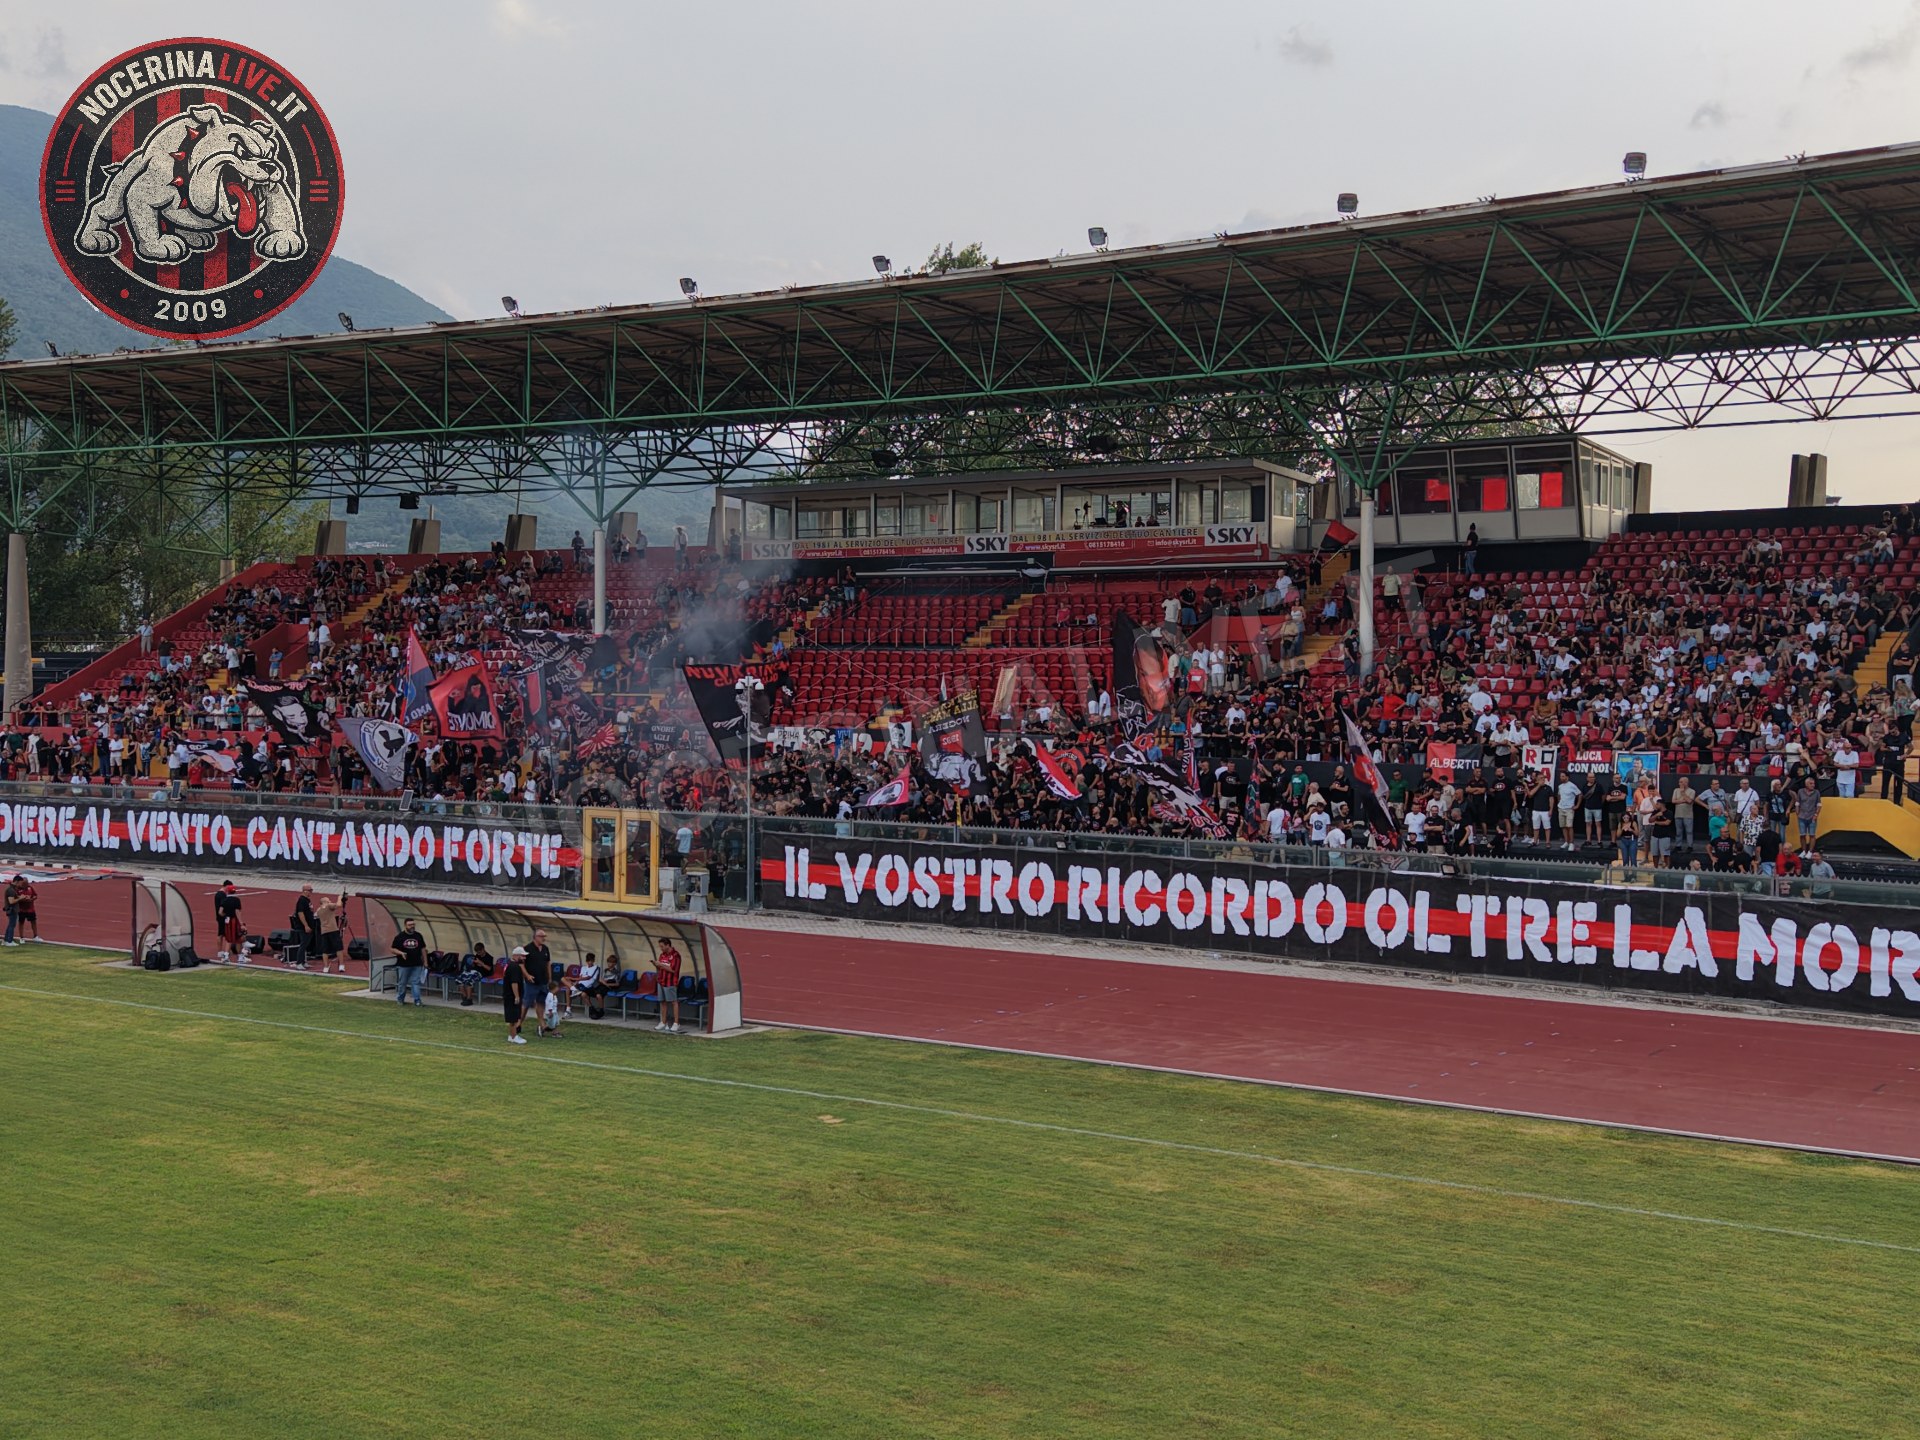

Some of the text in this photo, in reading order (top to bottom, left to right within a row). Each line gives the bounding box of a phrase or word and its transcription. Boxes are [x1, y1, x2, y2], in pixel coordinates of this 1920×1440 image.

[1012, 535, 1028, 543] DAL
[1032, 534, 1052, 542] 1981
[1056, 533, 1066, 541] AL
[1069, 530, 1110, 541] SERVIZIO
[1153, 528, 1198, 537] CANTIERE
[1218, 527, 1254, 543] SKY
[762, 543, 790, 558] SKY
[794, 541, 809, 549] DAL
[813, 541, 830, 549] 1981
[834, 540, 843, 548] AL
[845, 540, 880, 548] SERVIZIO
[884, 539, 898, 547] DEL
[976, 537, 1007, 552] SKY
[1025, 543, 1066, 552] www.skysrl.it
[1576, 750, 1602, 761] LUCA
[1430, 757, 1479, 770] ALBERTO
[1567, 762, 1609, 774] CON NOI
[80, 806, 120, 850] AL
[246, 815, 435, 870] CANTANDO
[443, 826, 562, 880] FORTE
[784, 845, 827, 900] IL
[835, 850, 1056, 918] VOSTRO
[1066, 864, 1347, 945] RICORDO
[1364, 886, 1597, 965] OLTRE
[1613, 904, 1718, 979] LA
